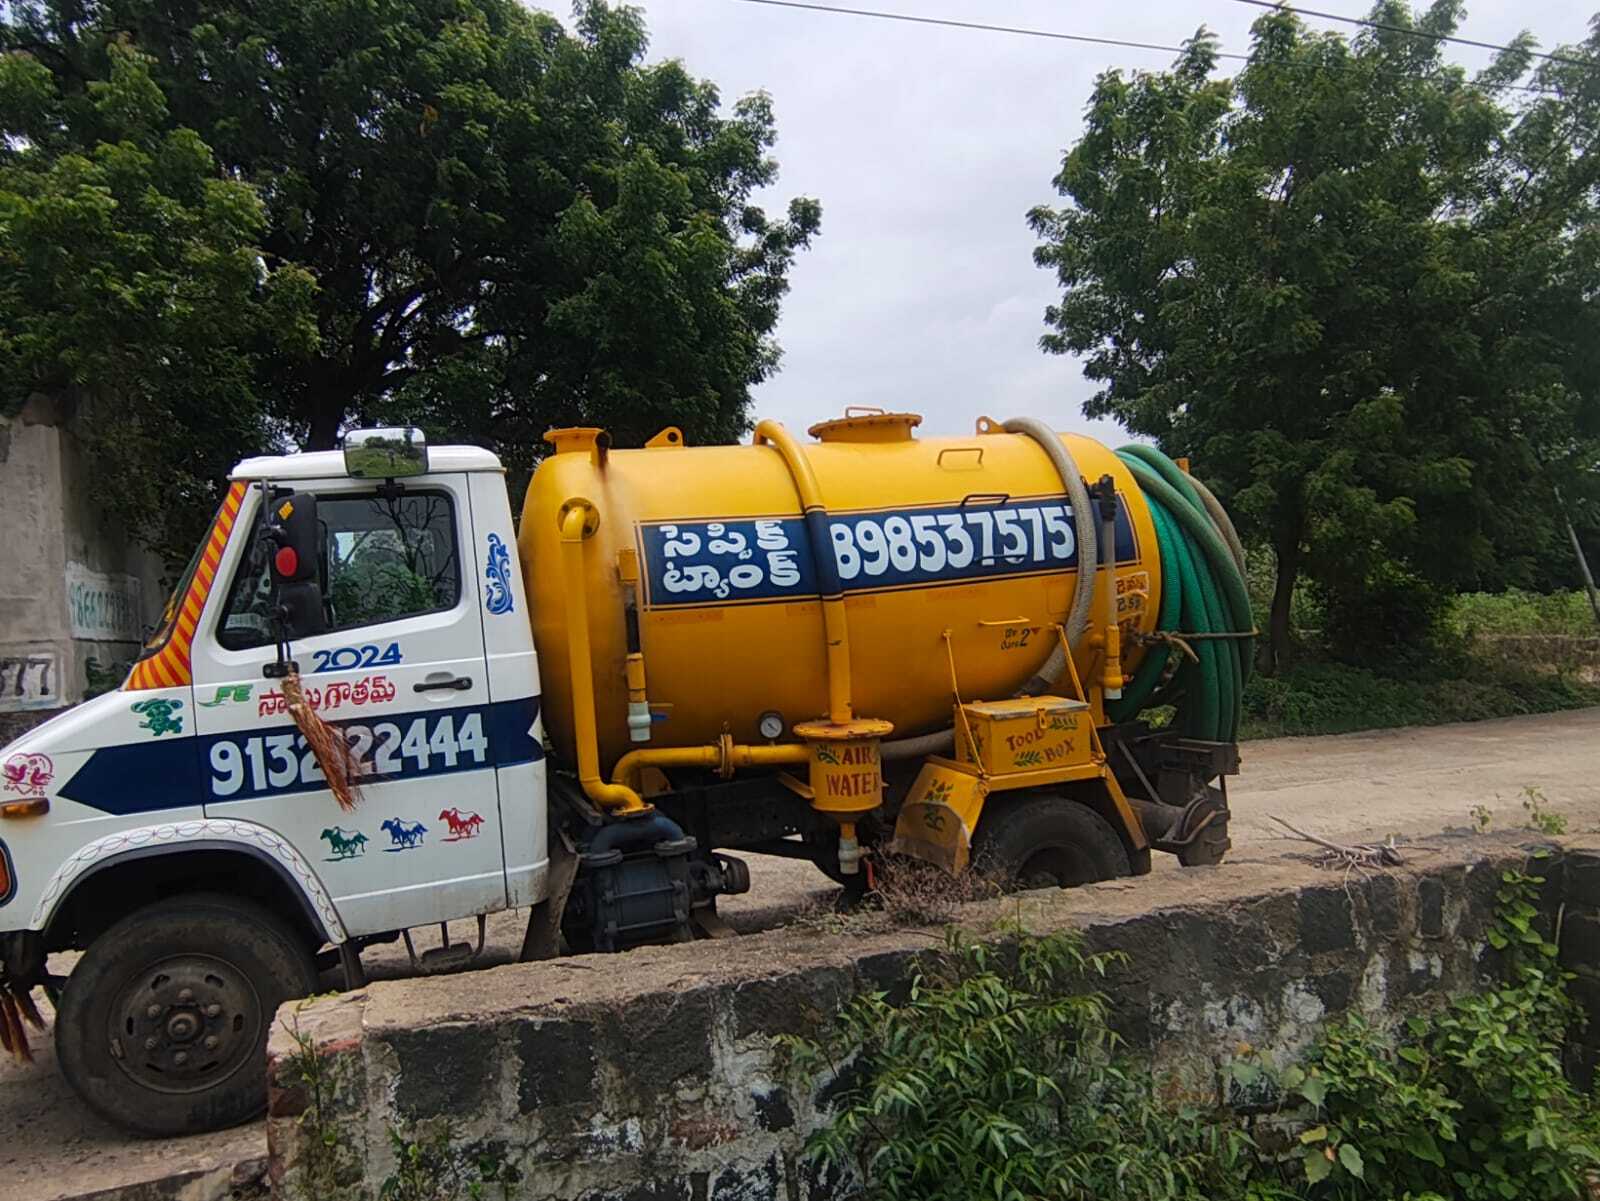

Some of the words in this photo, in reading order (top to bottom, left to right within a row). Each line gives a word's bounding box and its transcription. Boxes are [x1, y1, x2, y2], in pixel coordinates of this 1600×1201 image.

[660, 519, 789, 560] సెప్టిక్
[663, 550, 801, 598] ట్యాంక్
[312, 642, 403, 673] 2024
[841, 746, 876, 766] AIR
